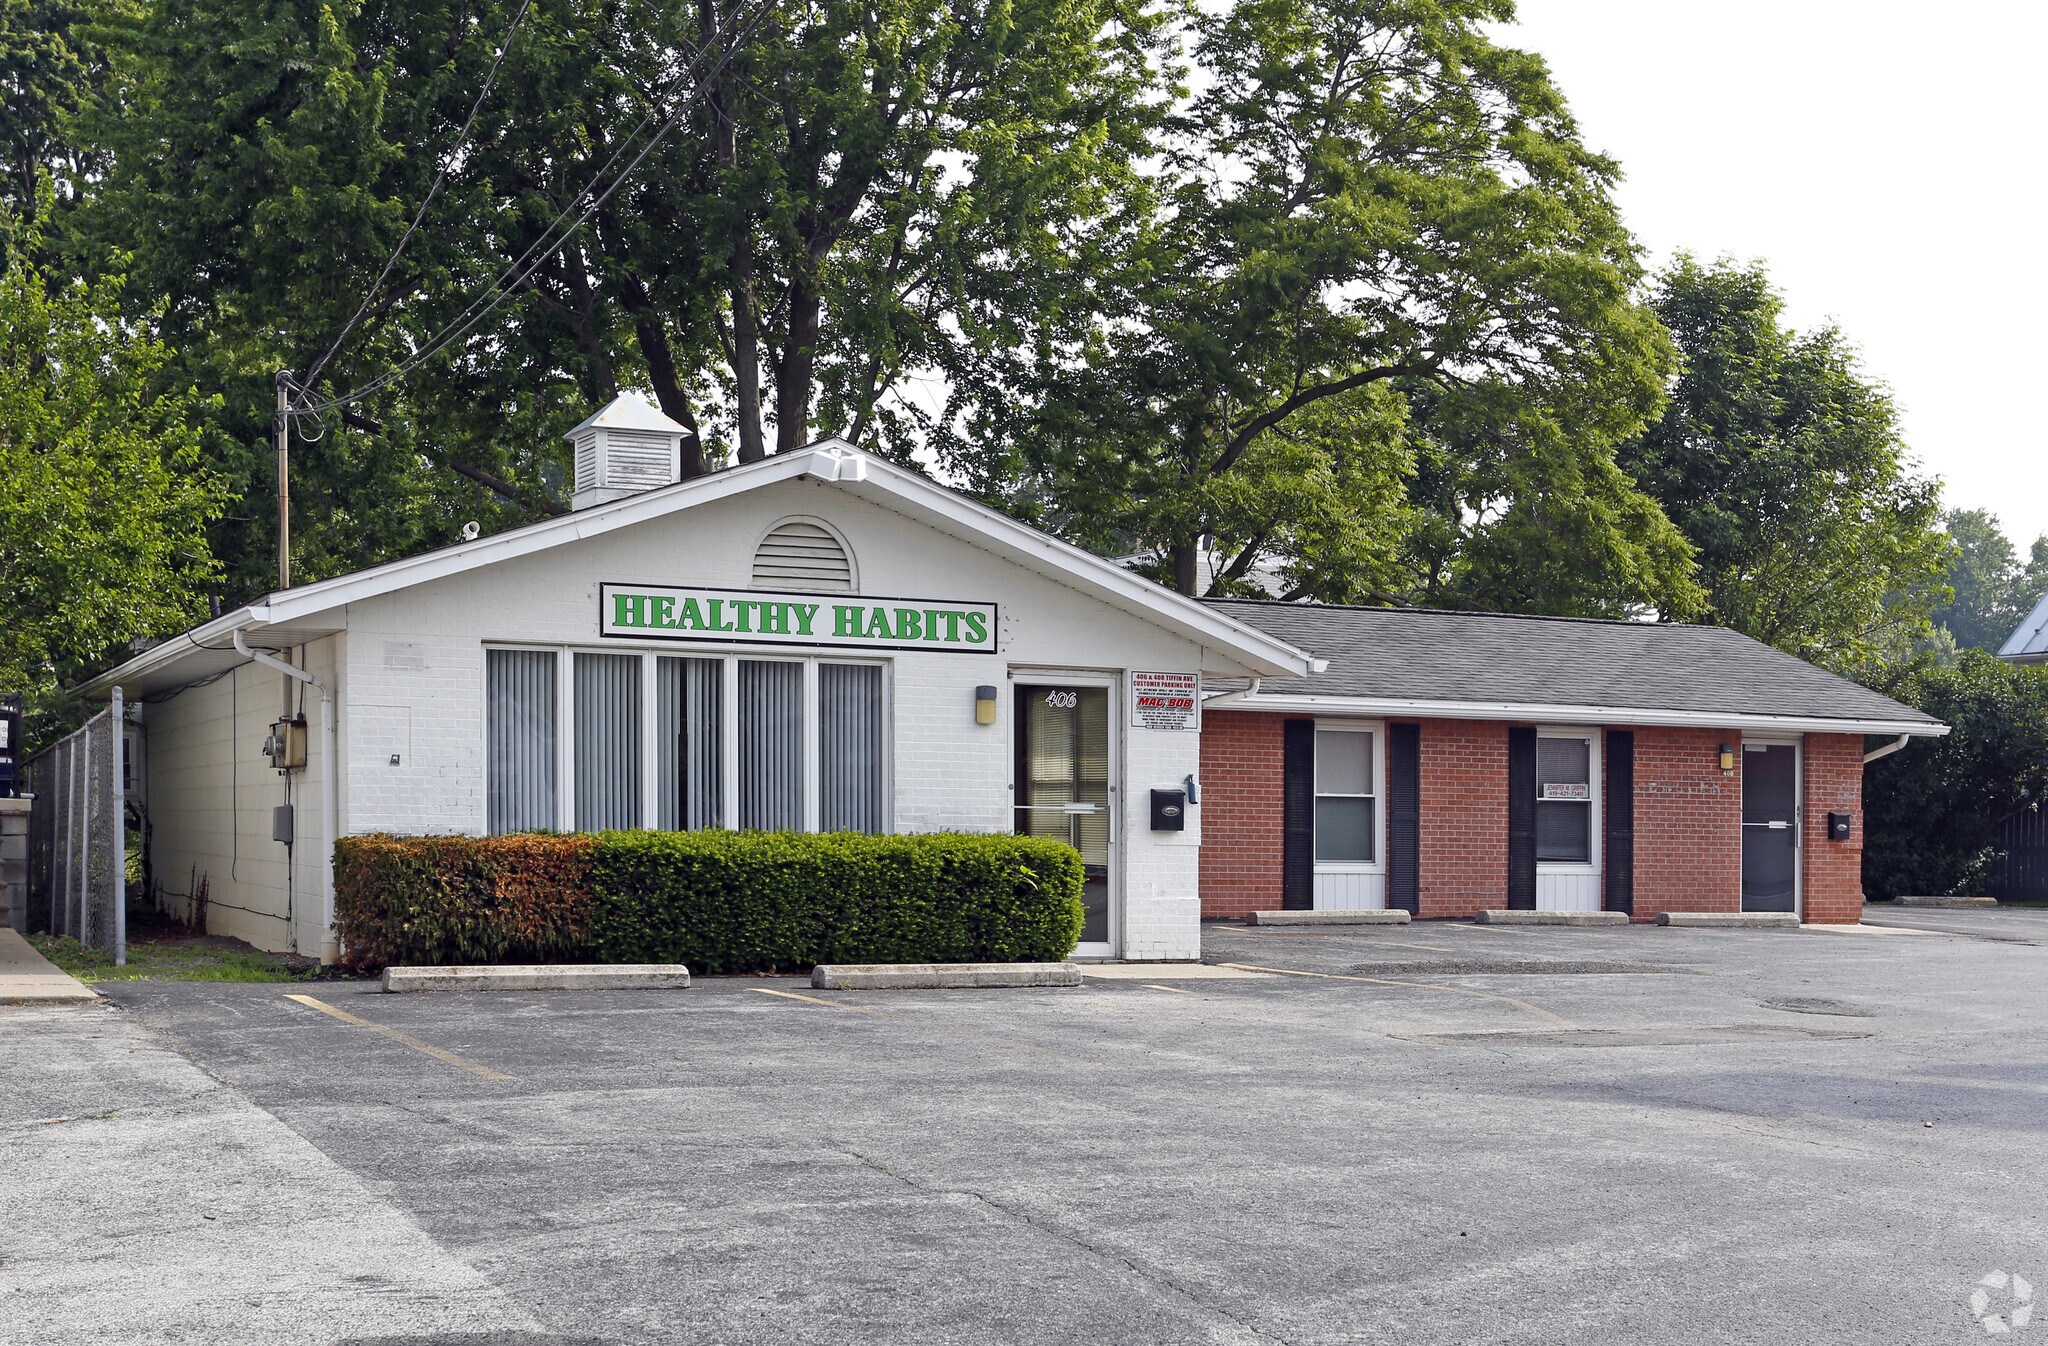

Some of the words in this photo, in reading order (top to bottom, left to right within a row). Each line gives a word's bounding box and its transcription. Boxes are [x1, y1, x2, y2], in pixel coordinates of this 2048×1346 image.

[612, 594, 819, 635] HEALTHY
[832, 605, 988, 643] HABITS
[1045, 690, 1078, 708] 406
[1138, 697, 1164, 707] MAC
[1167, 698, 1192, 707] BOB
